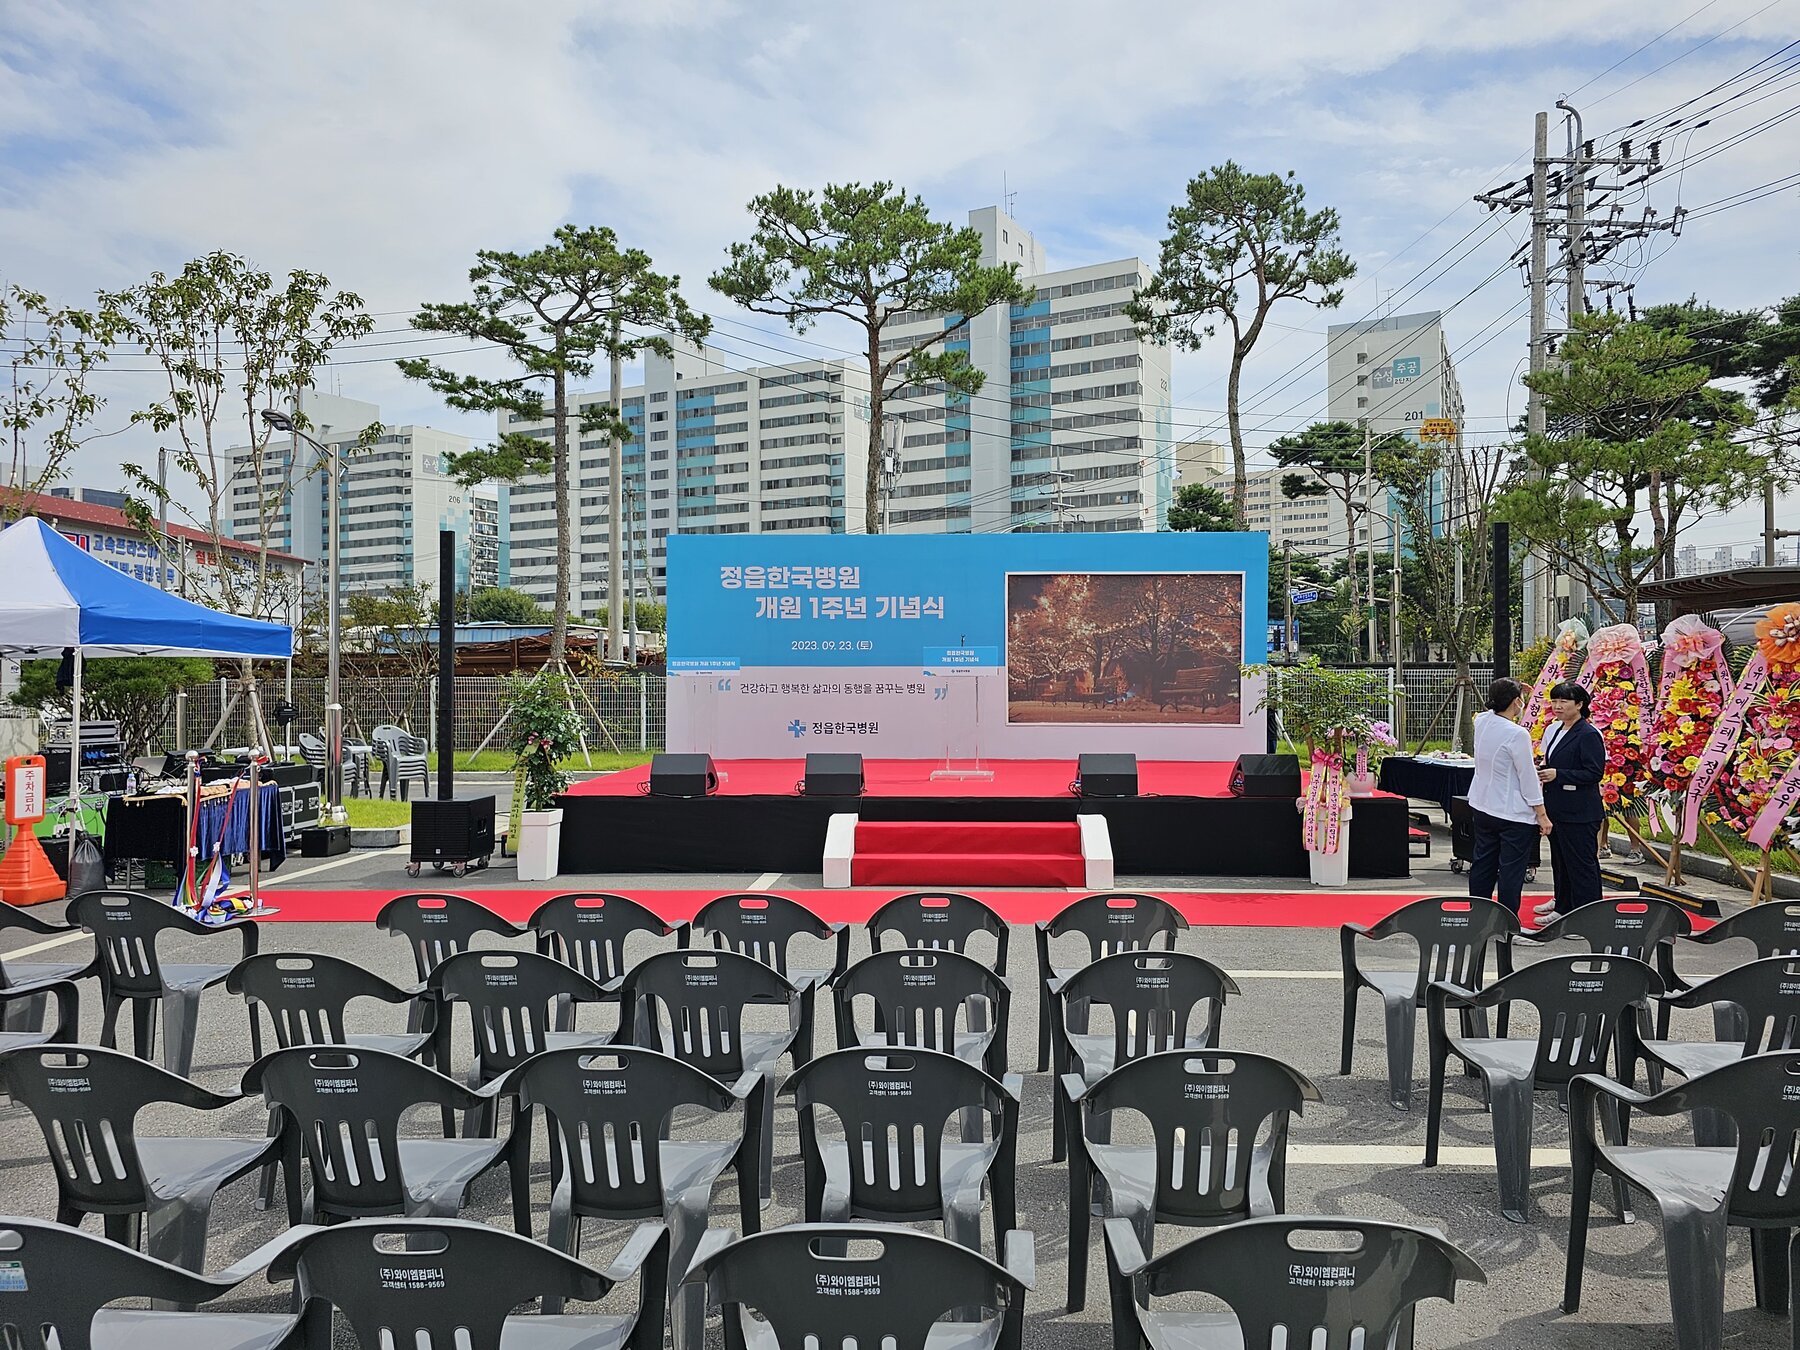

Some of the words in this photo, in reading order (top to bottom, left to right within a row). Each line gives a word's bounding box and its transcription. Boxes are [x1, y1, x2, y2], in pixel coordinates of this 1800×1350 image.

[1373, 369, 1393, 382] 수성
[1397, 361, 1417, 374] 주공
[1394, 376, 1412, 385] 2단지
[1404, 411, 1424, 421] 201
[448, 496, 461, 504] 206
[720, 566, 861, 589] 정읍한국병원
[755, 596, 801, 619] 개원
[809, 596, 867, 620] 1주년
[875, 596, 944, 619] 기념식
[791, 641, 819, 650] 2023.
[821, 641, 836, 650] 09.
[838, 641, 854, 651] 23.
[856, 640, 873, 651] (토)
[740, 683, 779, 695] 건강하고
[781, 683, 810, 695] 행복한
[812, 683, 841, 695] 삶과의
[844, 683, 872, 695] 동행을
[875, 683, 904, 695] 꿈꾸는
[906, 683, 926, 695] 병원
[812, 721, 879, 735] 정읍한국병원
[24, 770, 35, 814] 주차금지
[380, 1268, 443, 1280] (주)와이엠컴퍼니
[1289, 1265, 1355, 1278] (주)와이엠컴퍼니
[382, 1281, 406, 1289] 고객센터
[816, 1274, 880, 1287] (주)와이엠컴퍼니
[1289, 1278, 1315, 1286] 고객센터
[817, 1287, 841, 1295] 고객센터
